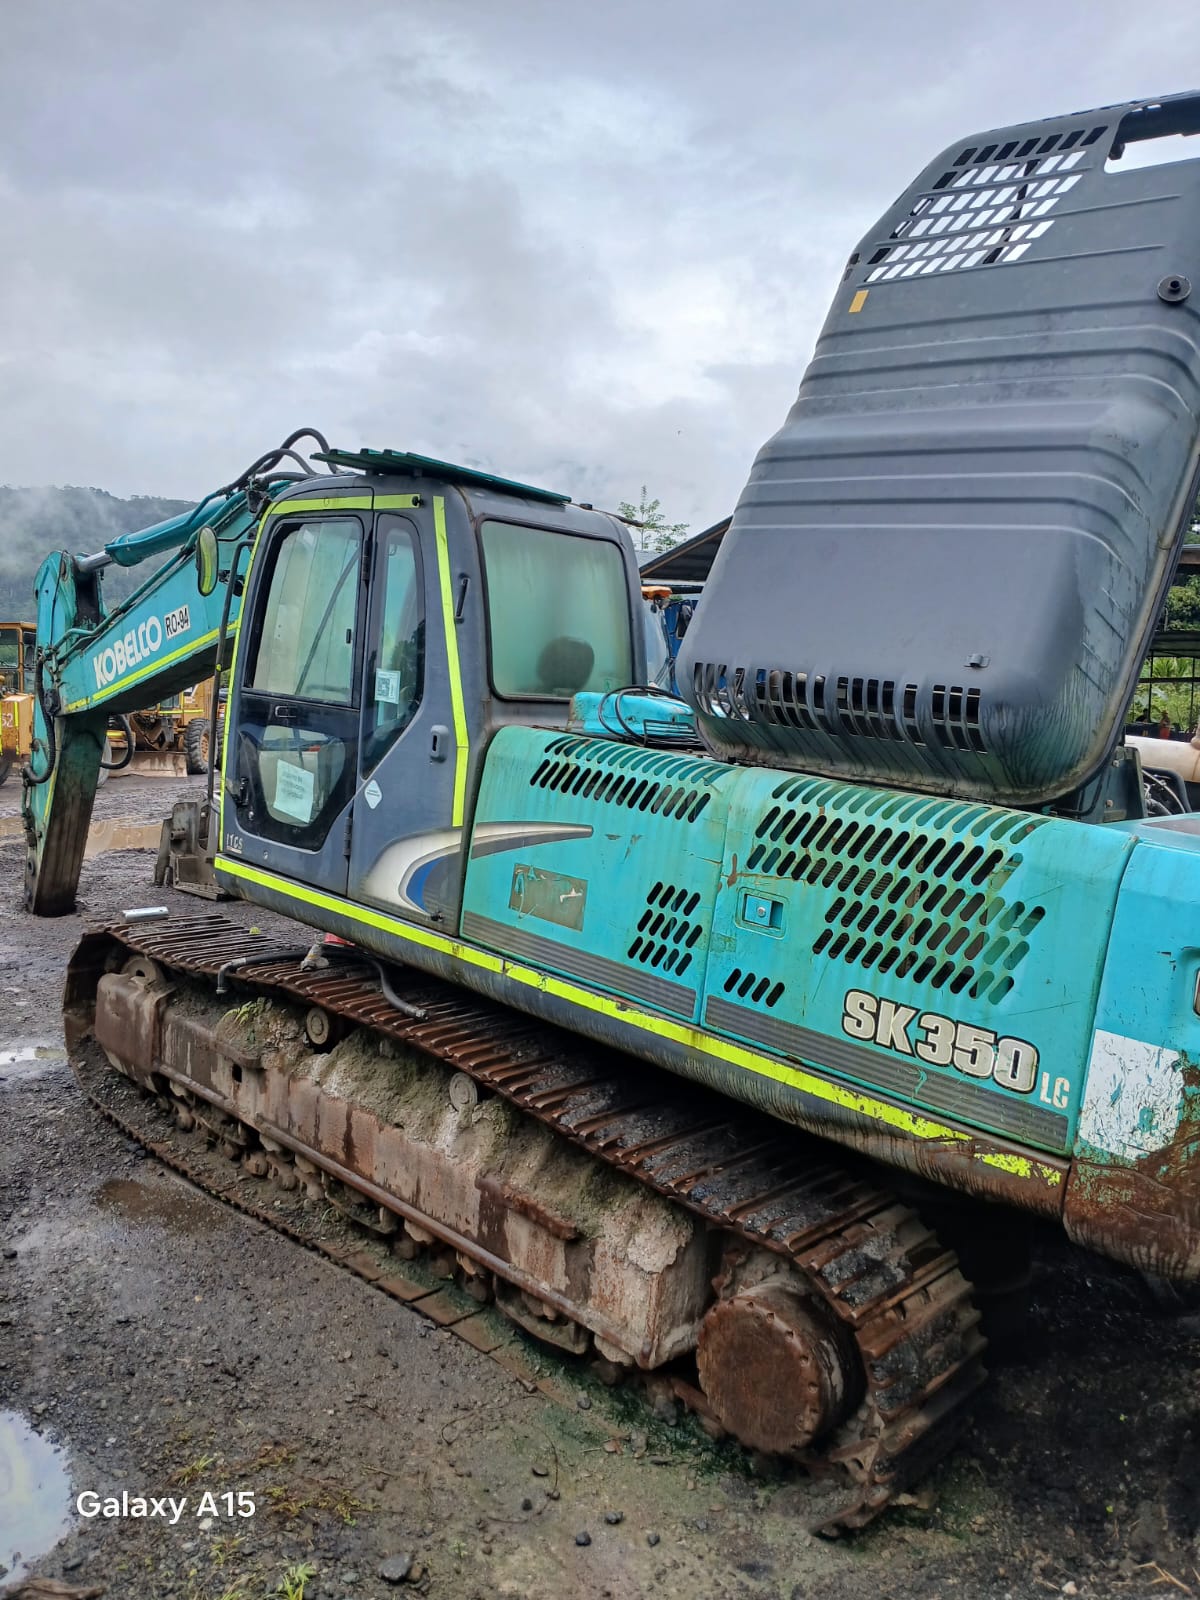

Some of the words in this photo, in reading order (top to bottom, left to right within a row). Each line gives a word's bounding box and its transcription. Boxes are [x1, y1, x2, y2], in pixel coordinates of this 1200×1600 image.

[93, 616, 162, 689] KOBELCO
[842, 989, 1040, 1094] SK350
[1040, 1072, 1070, 1109] LC
